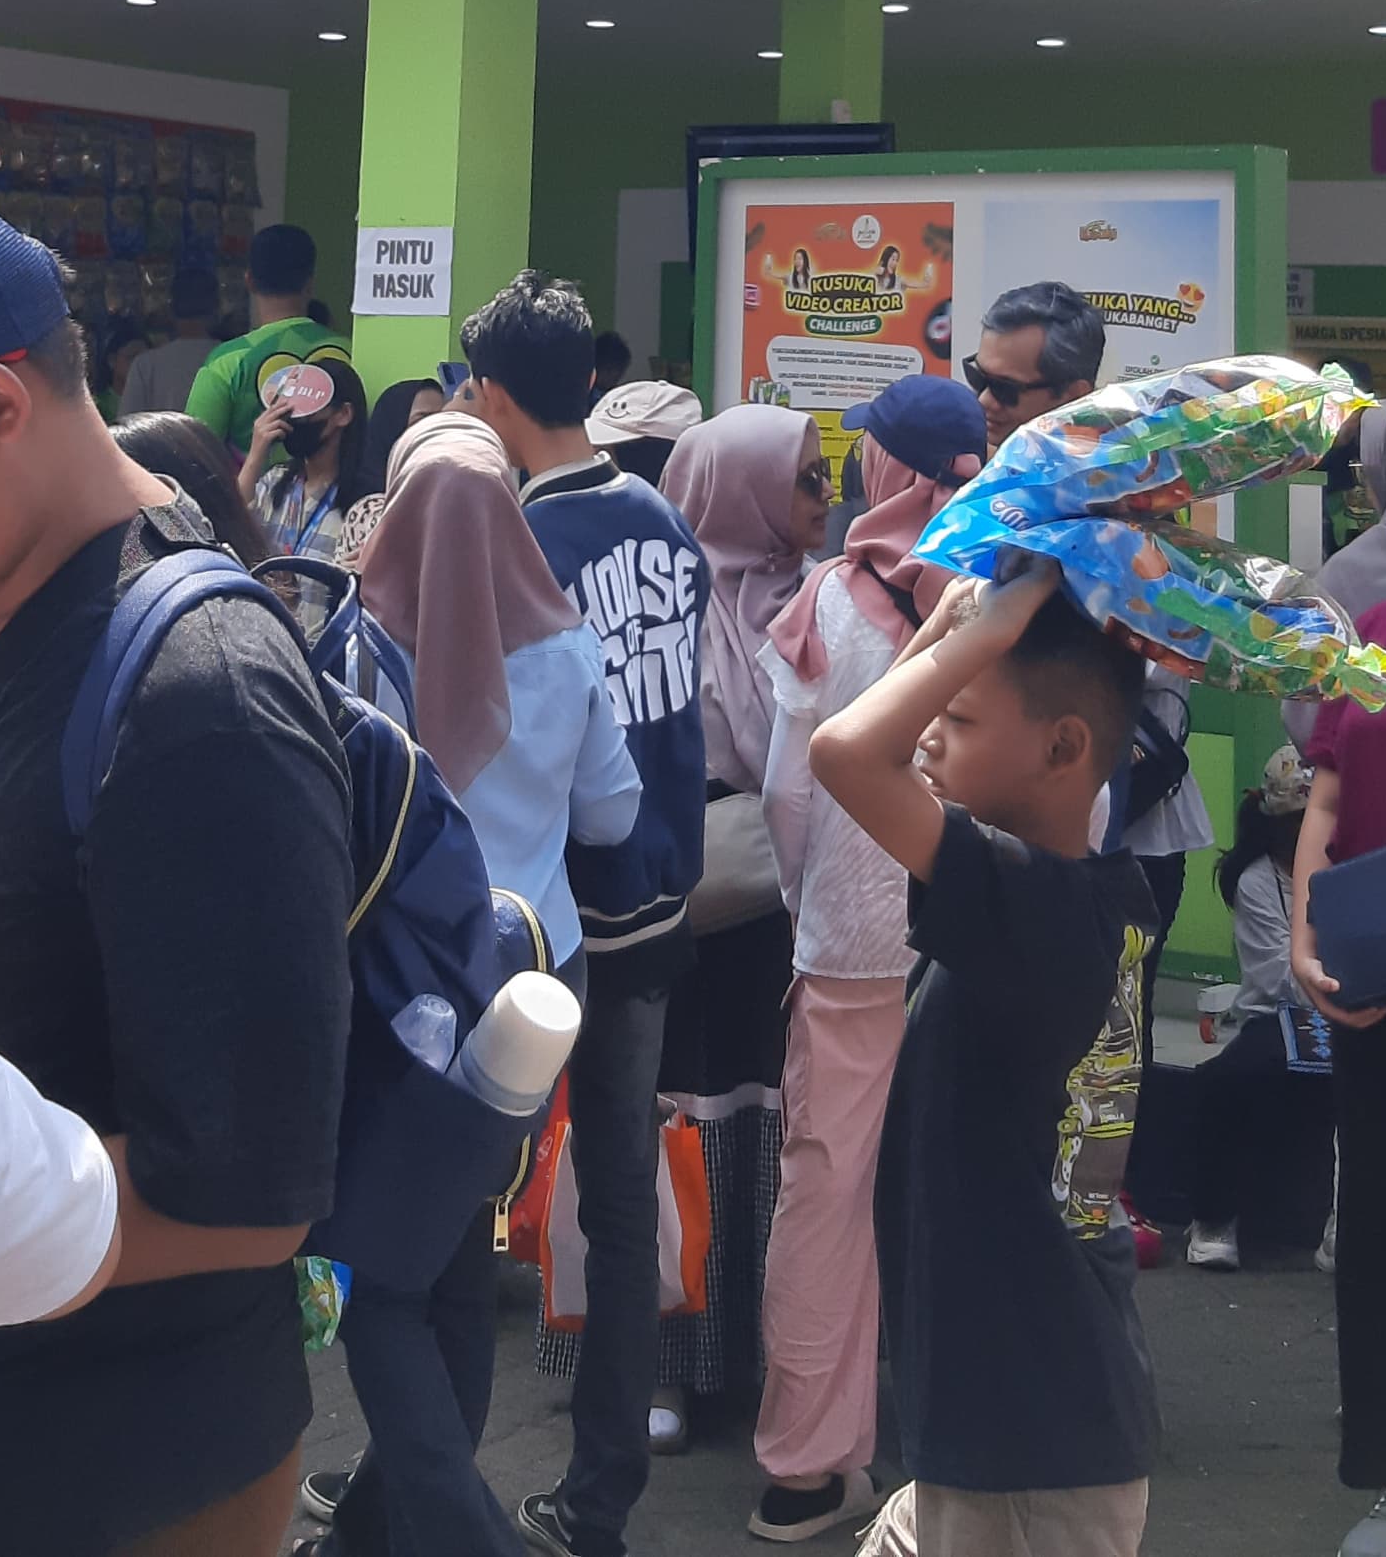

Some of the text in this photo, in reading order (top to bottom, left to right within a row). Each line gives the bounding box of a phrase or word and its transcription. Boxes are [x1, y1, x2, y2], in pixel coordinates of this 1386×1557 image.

[375, 239, 433, 267] PINTU
[372, 273, 435, 300] MASUK
[812, 275, 875, 295] KUSUKA
[786, 294, 902, 313] VIDEO CREATOR
[809, 317, 877, 333] CHALLENGE
[1295, 326, 1338, 341] HARGA
[625, 617, 643, 655] OF
